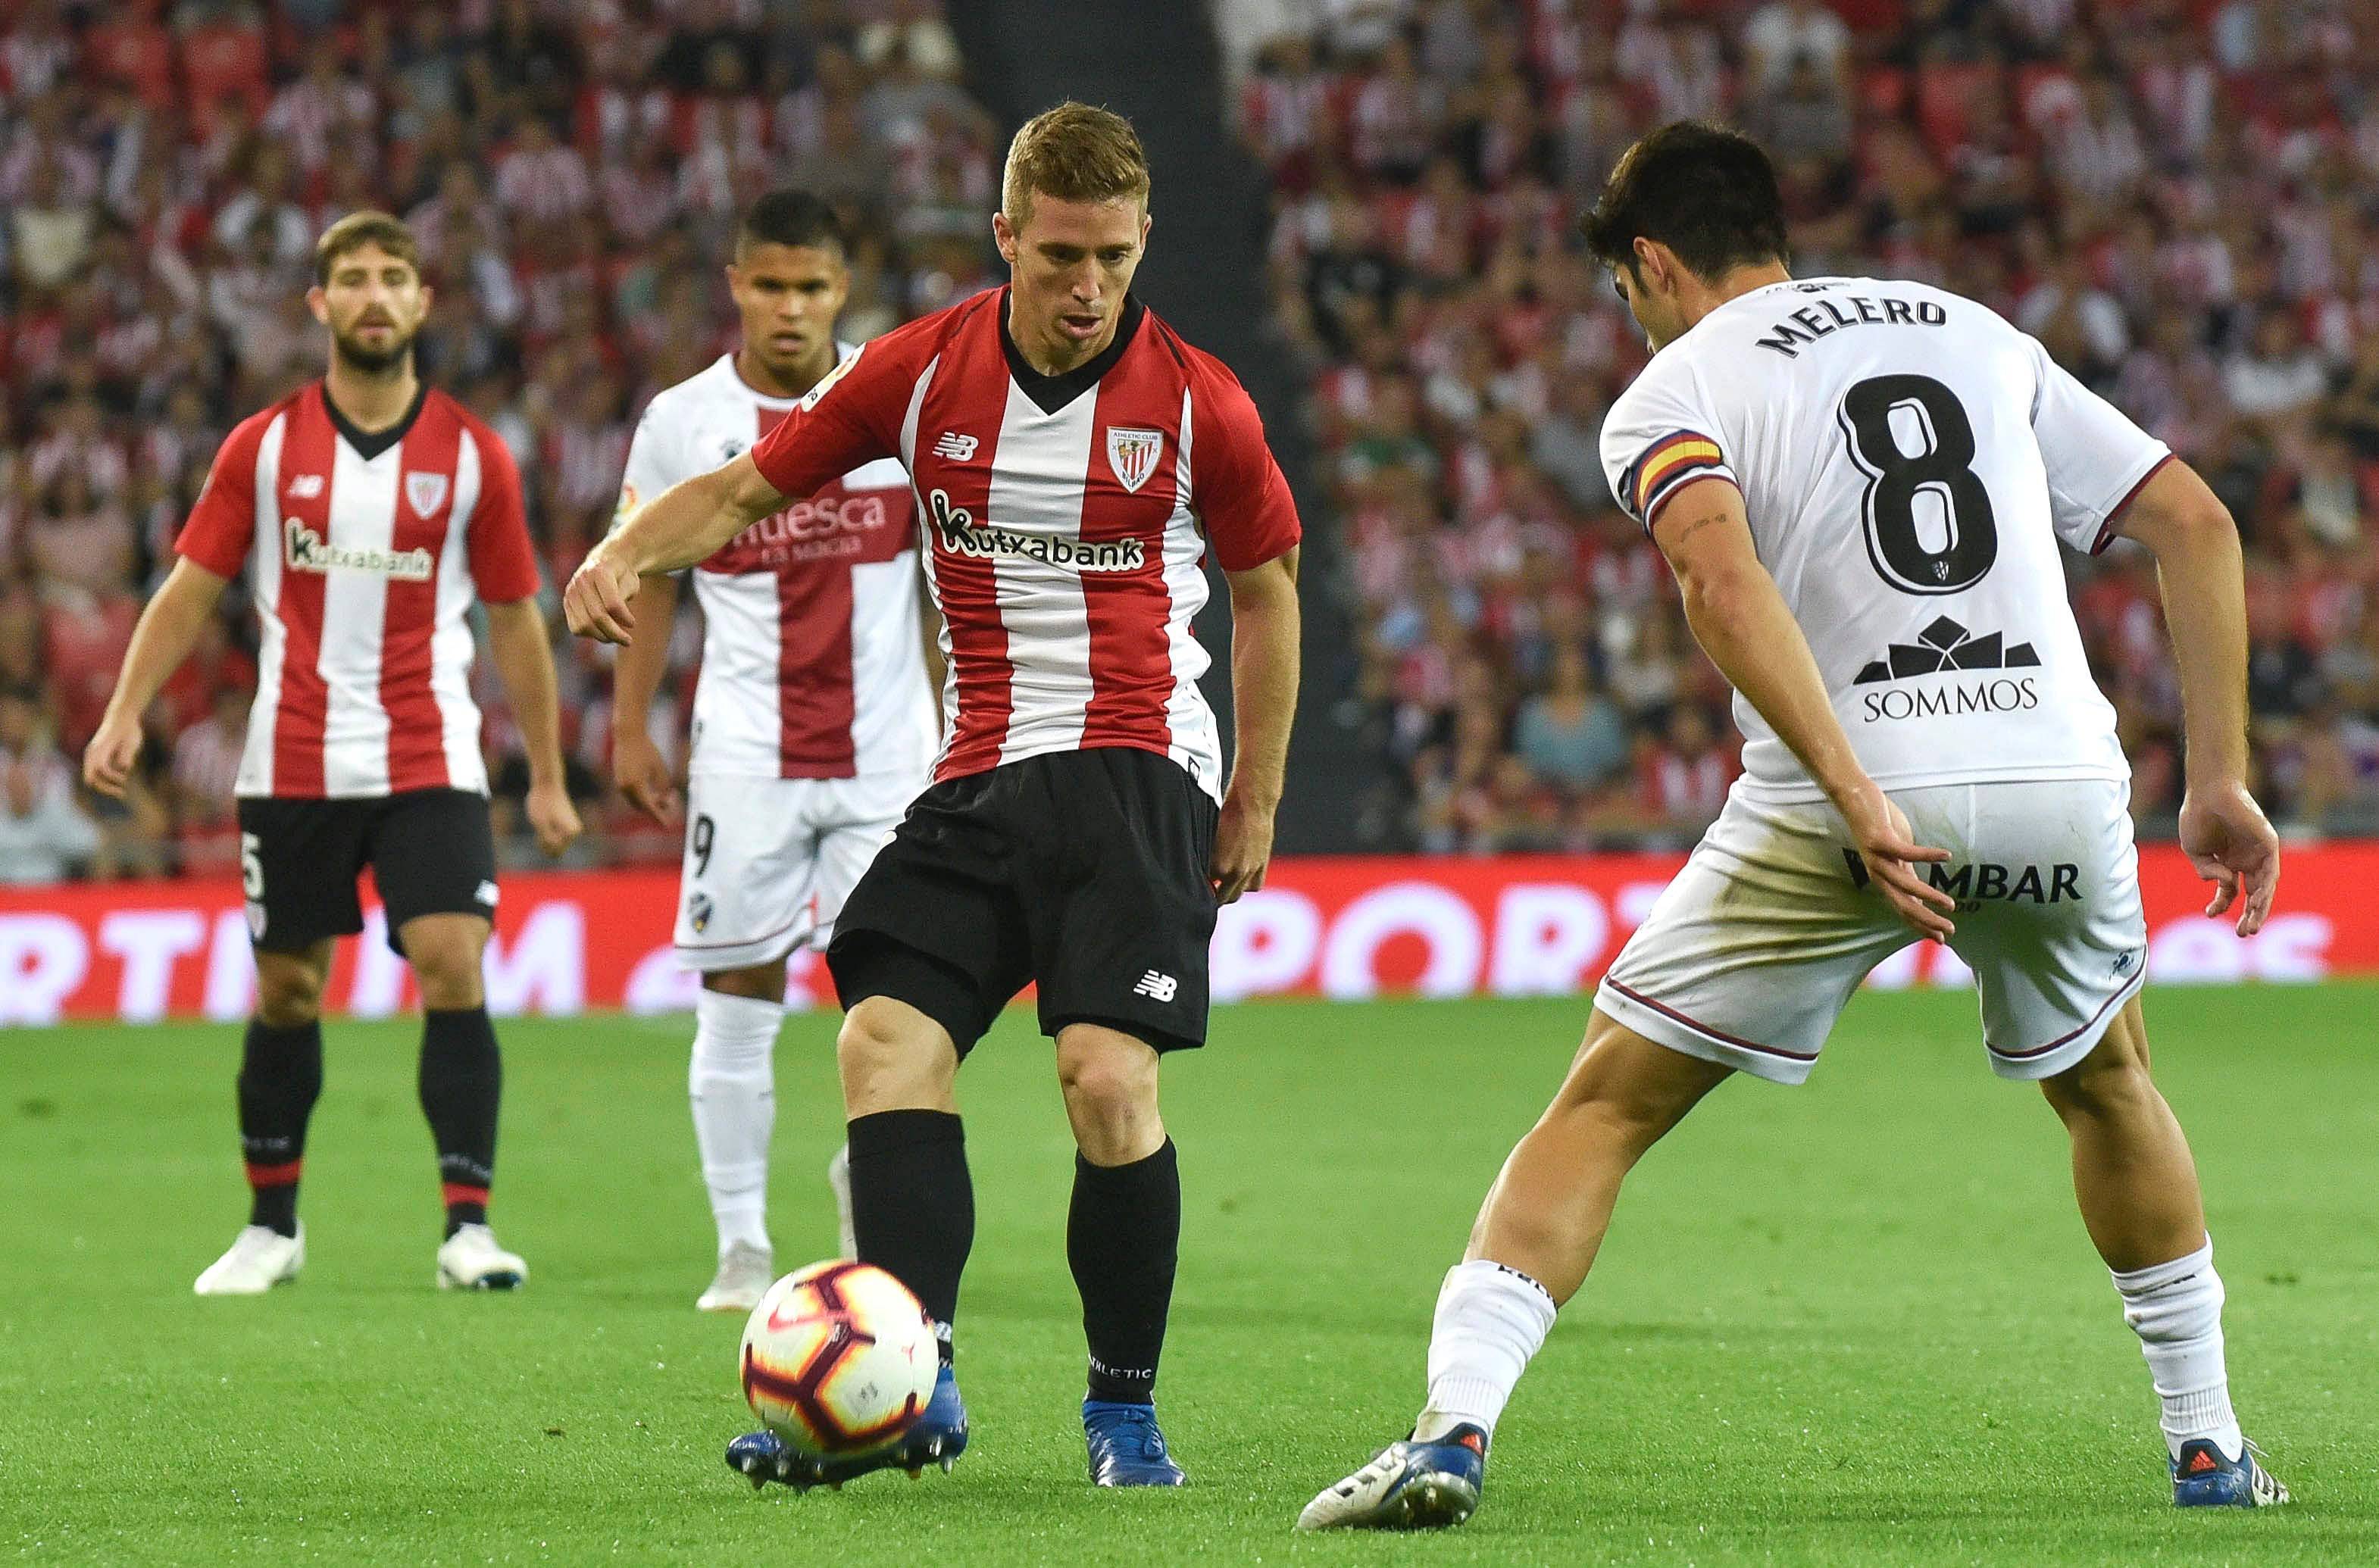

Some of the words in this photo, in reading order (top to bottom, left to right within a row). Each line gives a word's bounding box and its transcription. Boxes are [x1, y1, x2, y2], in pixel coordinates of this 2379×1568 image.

[1755, 297, 1946, 359] MELERO
[1837, 373, 1999, 597] 8
[1864, 678, 2038, 723] SOMMOS
[241, 832, 265, 899] 5
[694, 813, 714, 879] 9
[1928, 863, 2084, 904] MBAR
